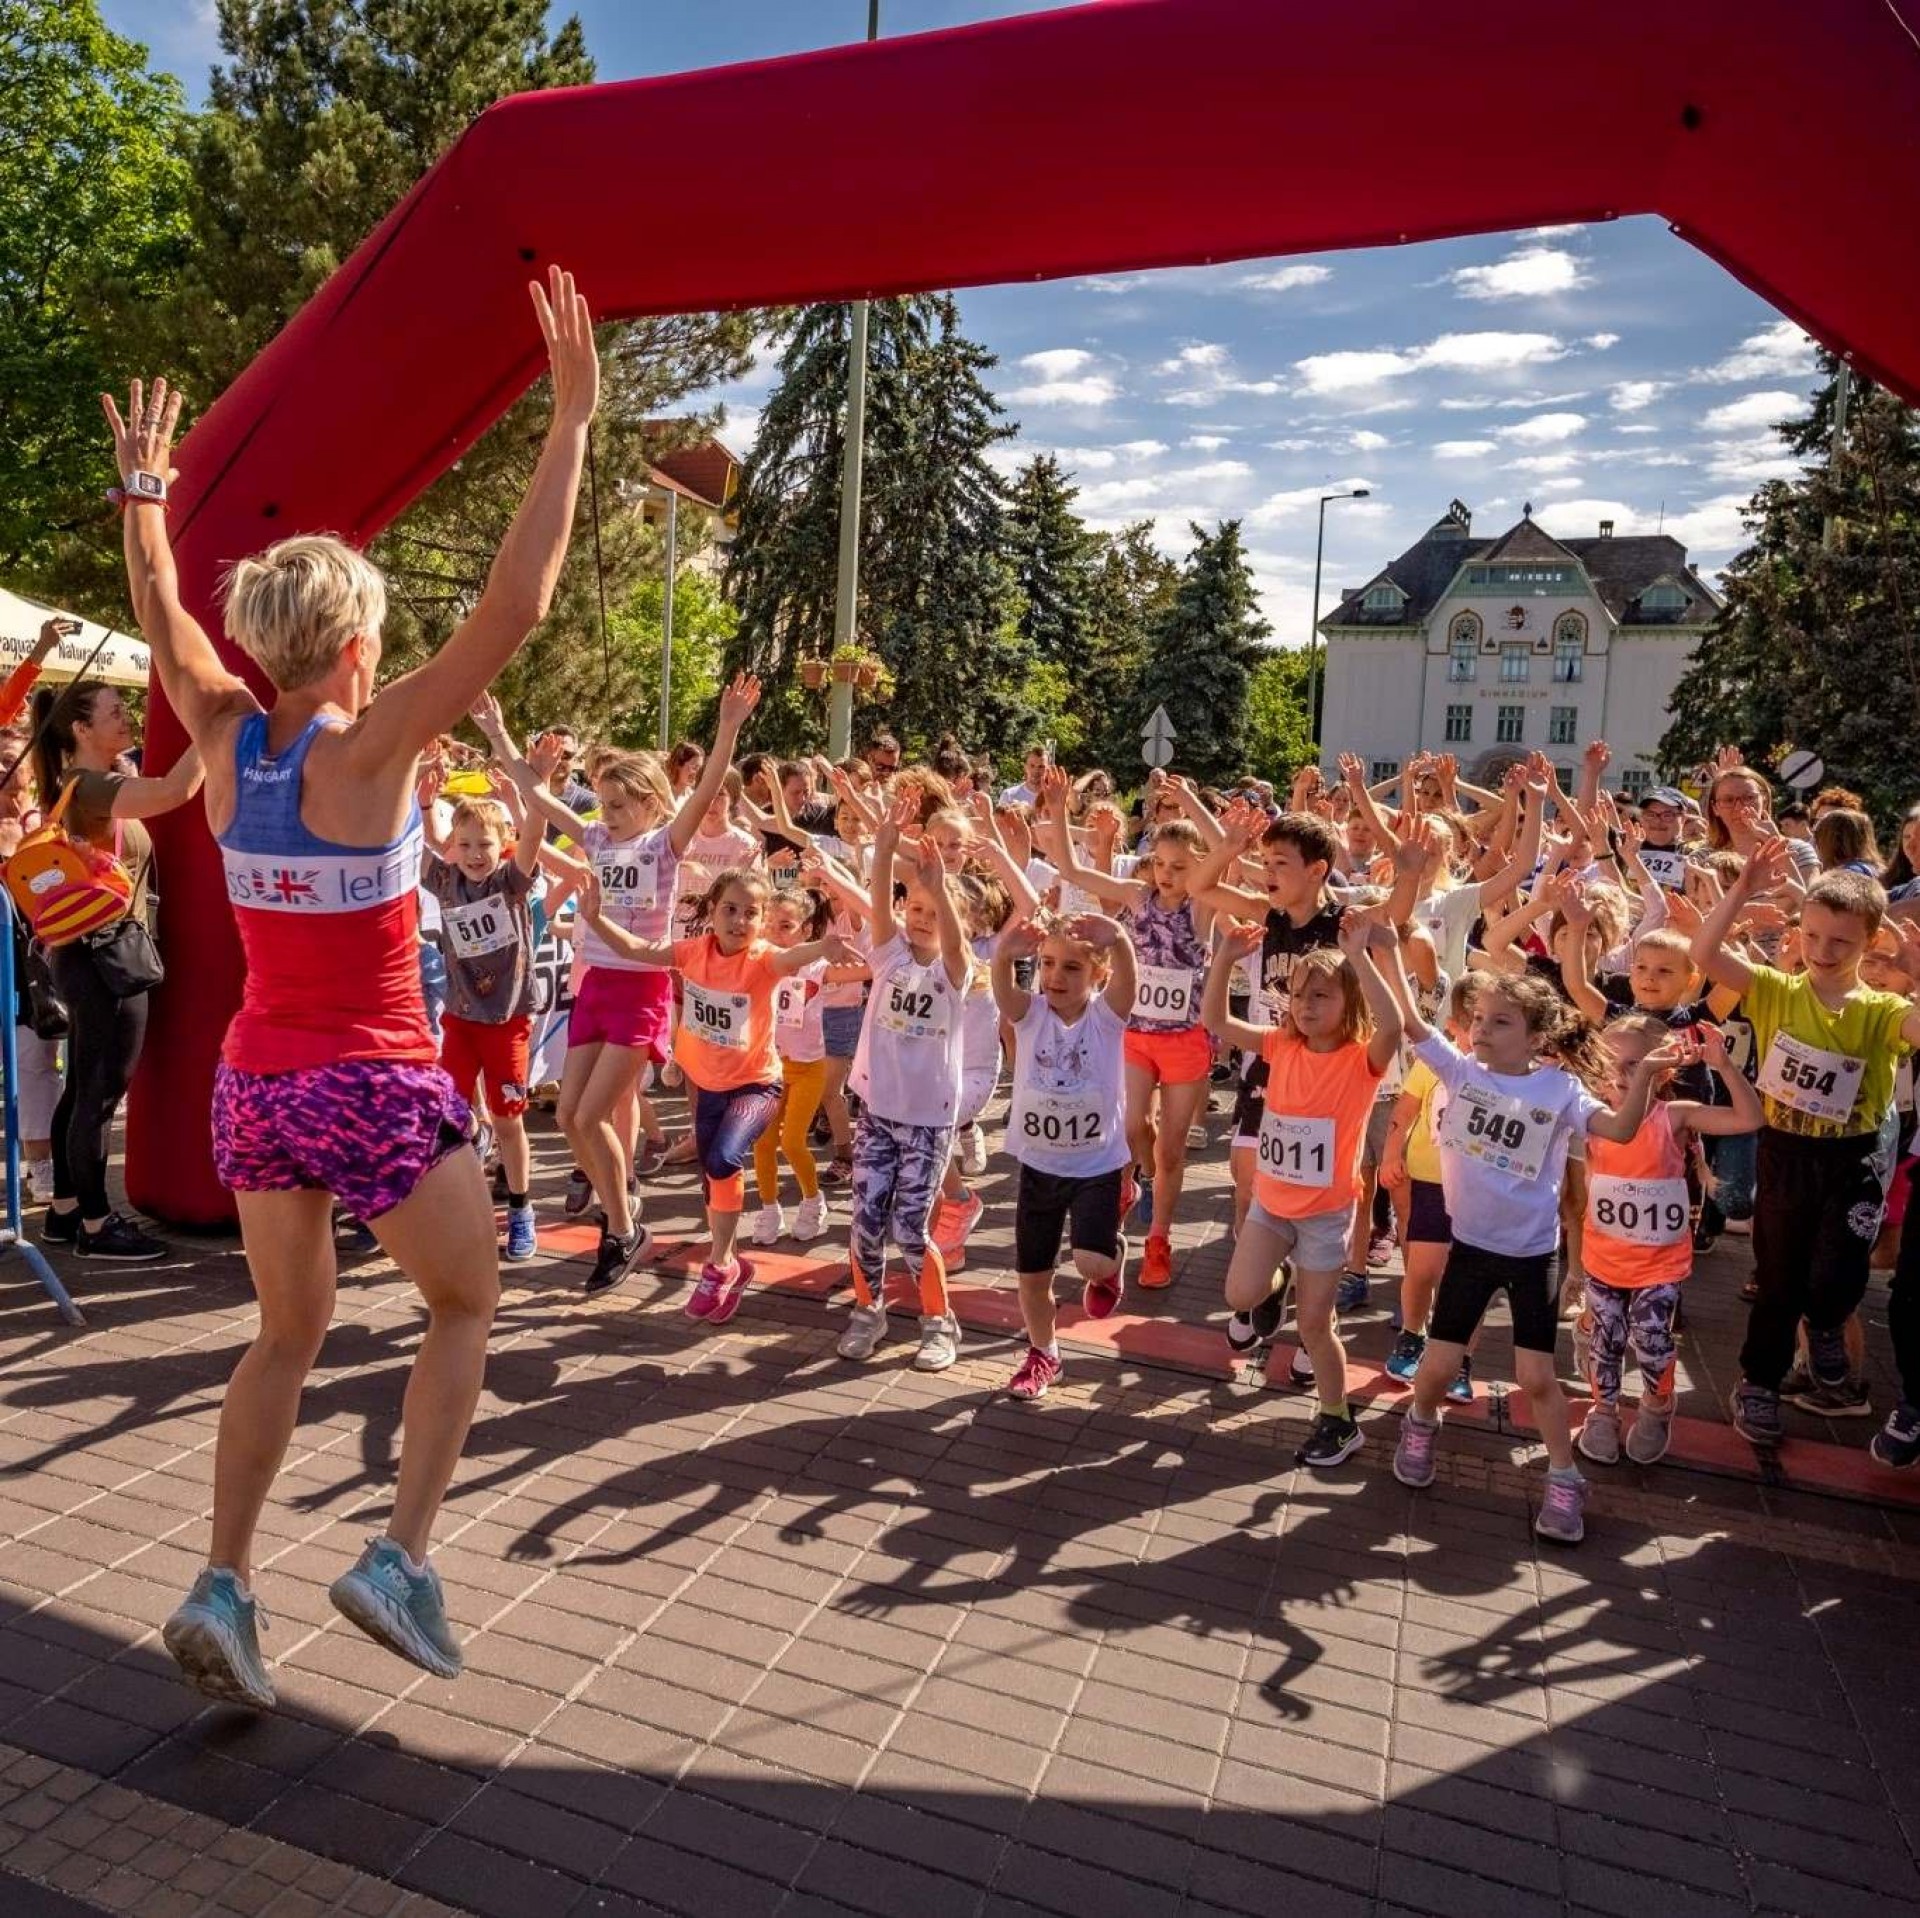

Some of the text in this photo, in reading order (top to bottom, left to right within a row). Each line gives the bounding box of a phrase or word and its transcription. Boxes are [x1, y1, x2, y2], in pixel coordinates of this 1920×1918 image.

[602, 865, 638, 889] 520
[457, 914, 496, 941] 510
[890, 987, 933, 1018] 542
[1139, 983, 1185, 1010] 009
[694, 1000, 731, 1030] 505
[1781, 1055, 1837, 1096] 554
[1024, 1112, 1101, 1140] 8012
[1467, 1106, 1526, 1149] 549
[1260, 1131, 1325, 1172] 8011
[1597, 1198, 1685, 1231] 8019
